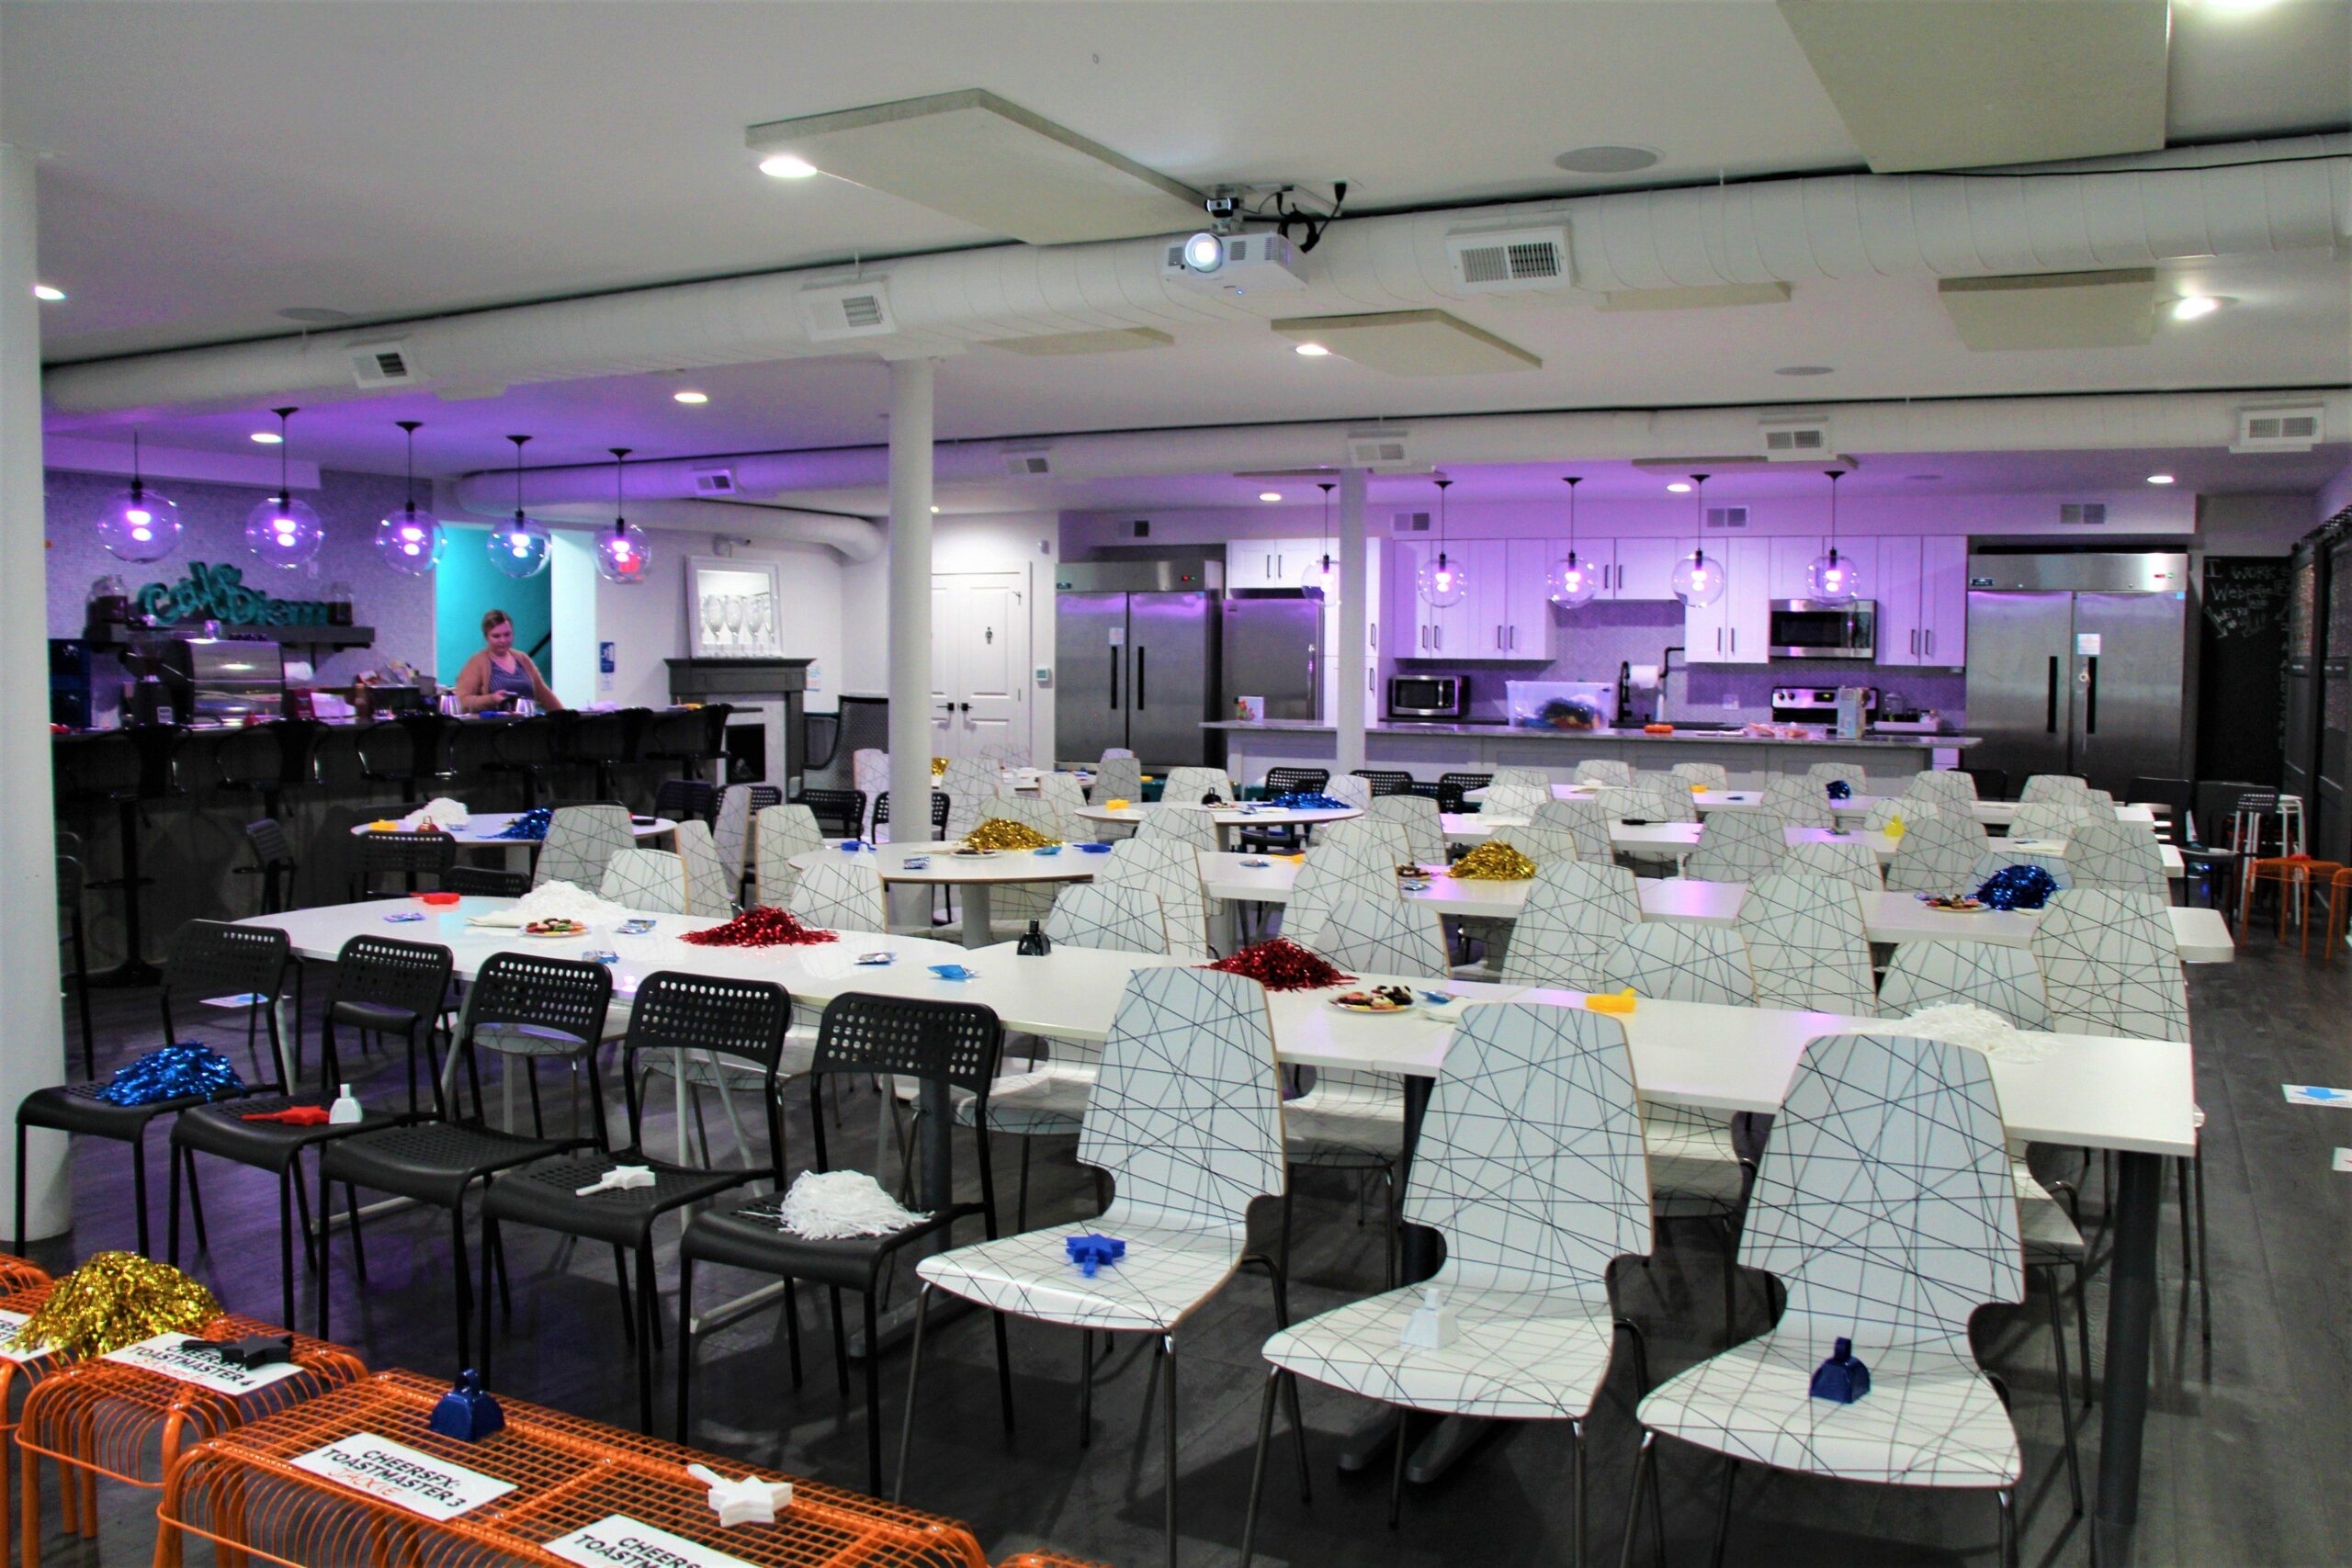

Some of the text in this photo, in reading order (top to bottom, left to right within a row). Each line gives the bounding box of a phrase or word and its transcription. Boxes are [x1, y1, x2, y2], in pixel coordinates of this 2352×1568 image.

[128, 1346, 245, 1382] TOASTMASTER
[322, 1448, 467, 1507] TOASTMASTER 3
[362, 1450, 460, 1489] CHEERSFX:
